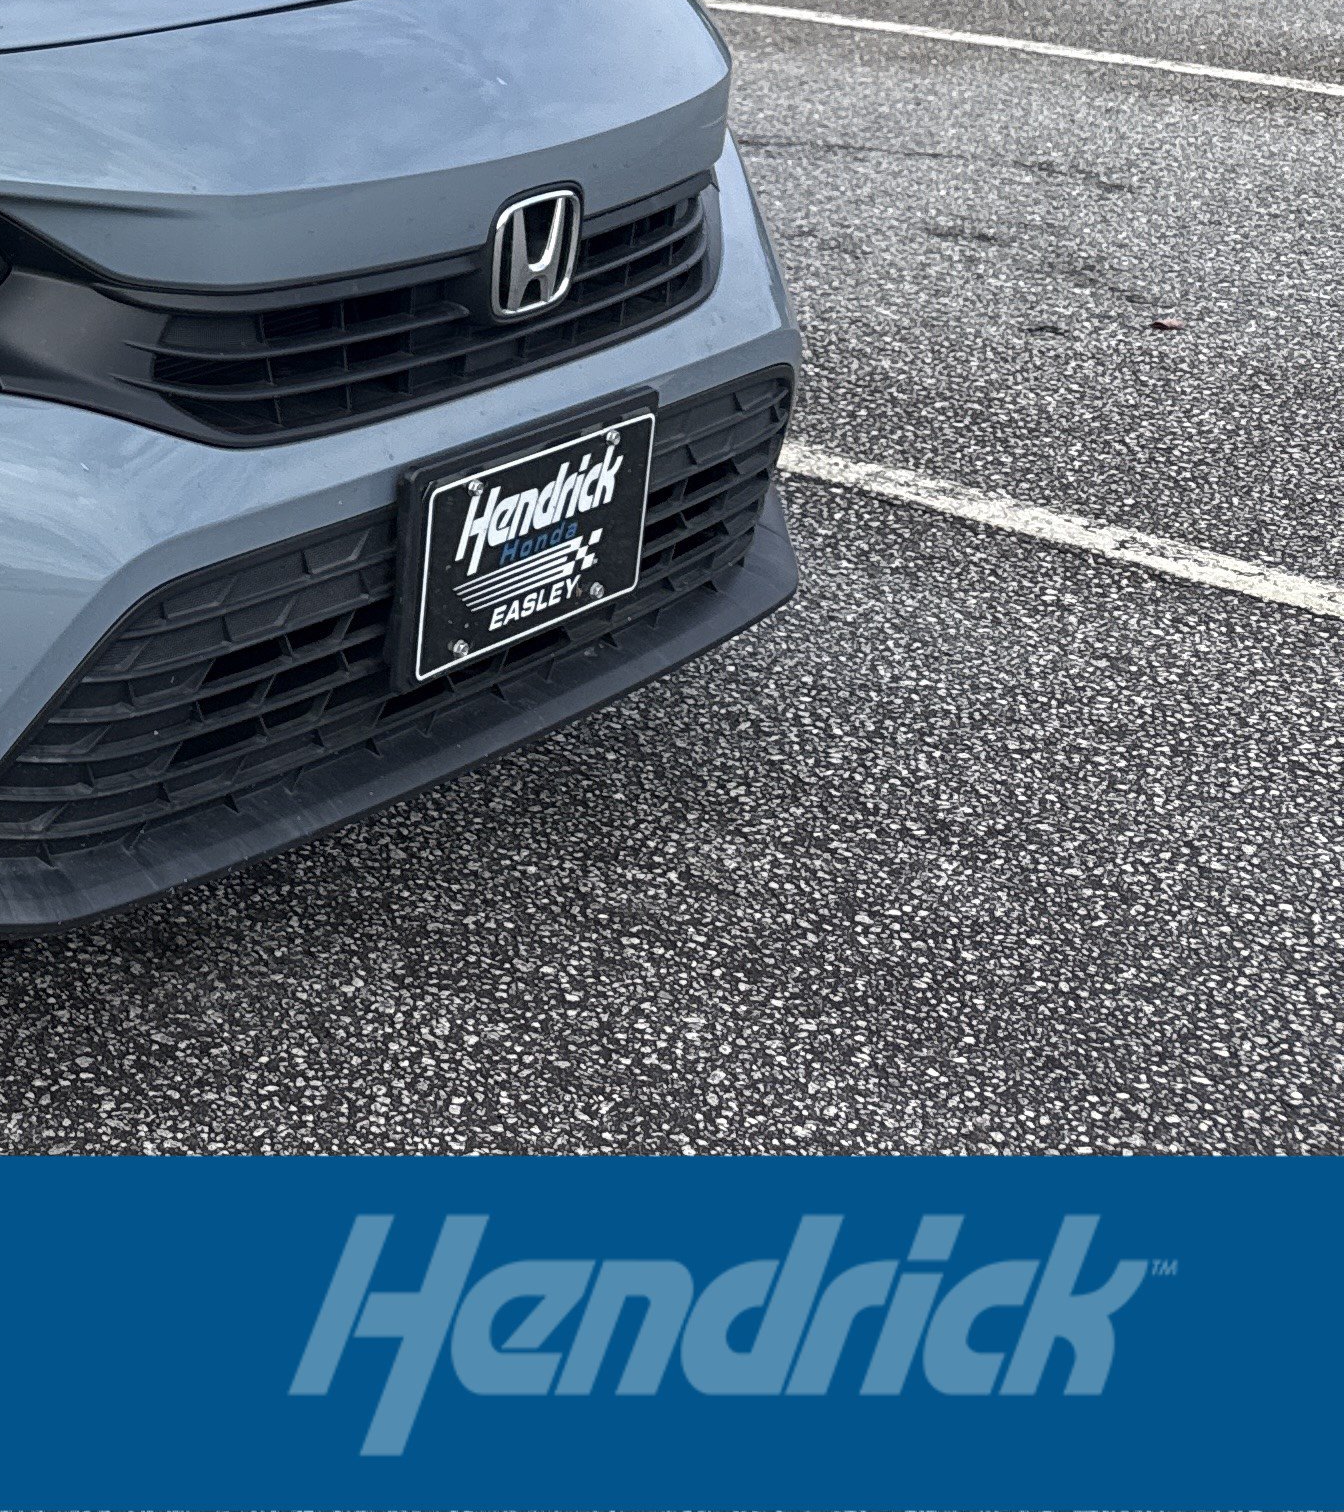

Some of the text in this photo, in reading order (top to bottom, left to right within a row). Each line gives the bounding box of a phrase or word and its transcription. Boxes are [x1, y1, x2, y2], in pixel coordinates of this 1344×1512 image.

[454, 444, 624, 577] Hendrick
[499, 519, 579, 567] Honda
[488, 574, 582, 632] EASLEY
